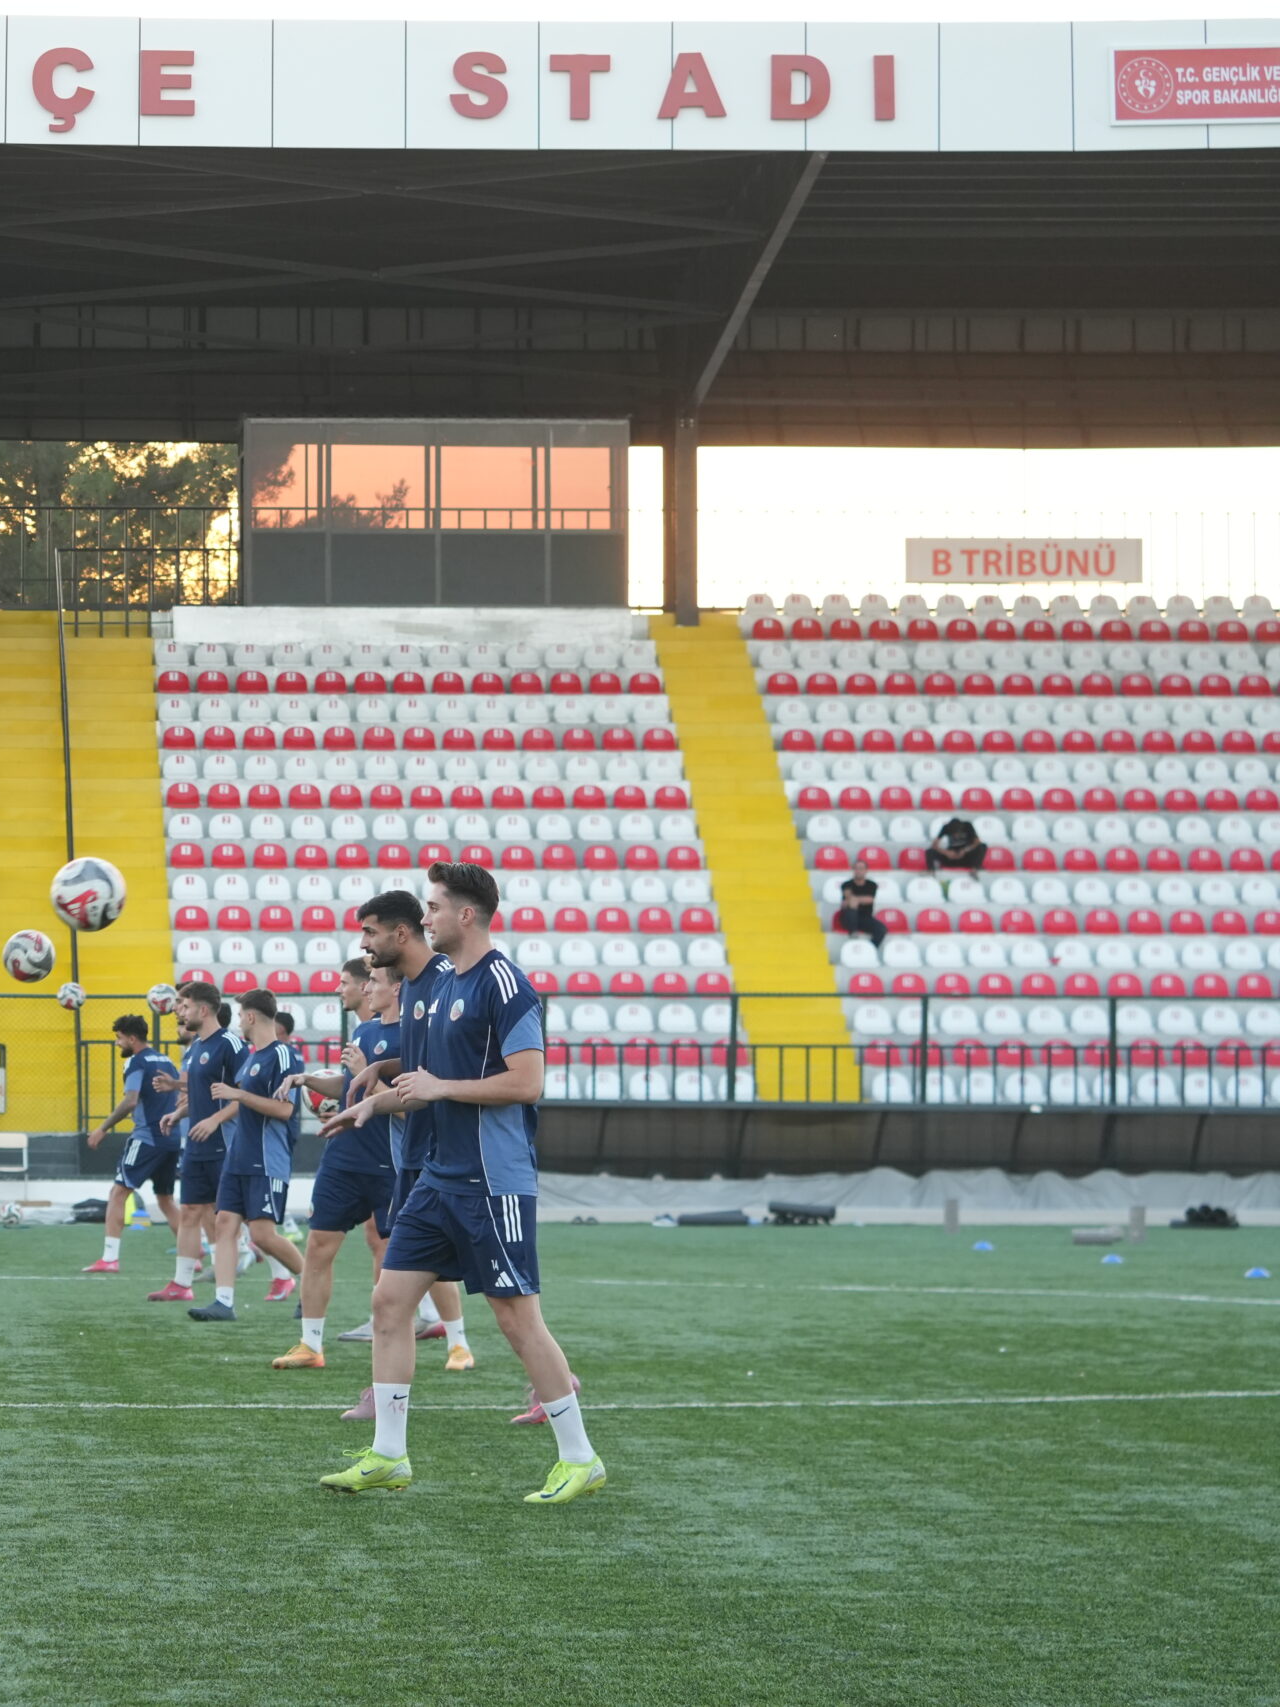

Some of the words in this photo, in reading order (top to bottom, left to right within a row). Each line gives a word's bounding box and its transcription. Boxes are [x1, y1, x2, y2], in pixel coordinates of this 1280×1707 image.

[448, 50, 895, 120] STADI
[1175, 67, 1199, 83] T.C.
[1202, 62, 1260, 85] GENÇLİK
[1263, 65, 1280, 81] VE
[1176, 90, 1210, 105] SPOR
[932, 549, 952, 576] B
[960, 543, 1116, 577] TRİBÜNÜ
